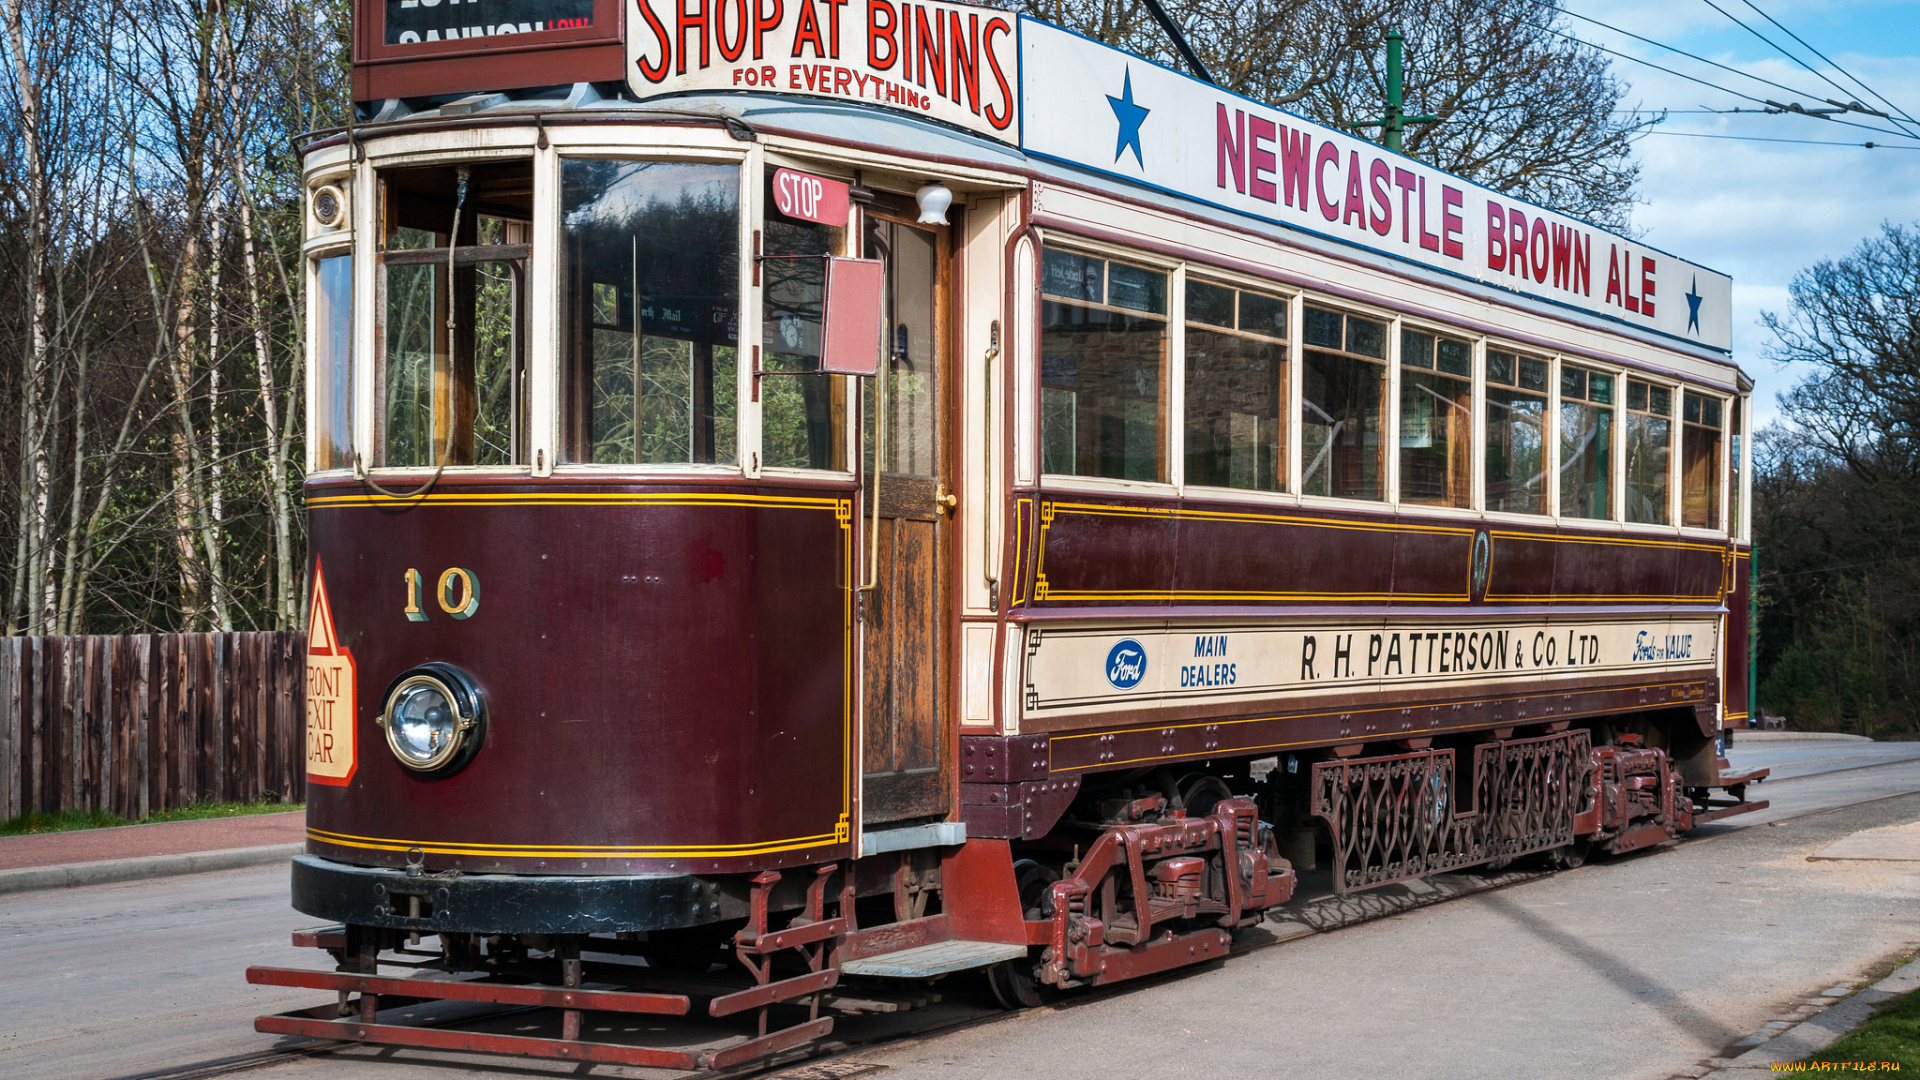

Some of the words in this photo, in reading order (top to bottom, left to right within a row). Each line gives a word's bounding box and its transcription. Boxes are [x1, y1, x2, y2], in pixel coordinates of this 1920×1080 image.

[635, 0, 785, 84] SHOP
[790, 0, 849, 60] AT
[866, 0, 1014, 131] BINNS
[732, 65, 776, 88] FOR
[789, 64, 931, 111] EVERYTHING
[778, 171, 823, 220] STOP
[1215, 101, 1464, 261] NEWCASTLE
[1487, 199, 1591, 298] BROWN
[1605, 243, 1656, 319] ALE
[404, 566, 481, 622] 10
[1109, 648, 1144, 682] Ford
[1193, 635, 1228, 658] MAIN
[1300, 635, 1319, 681] R.
[1333, 634, 1355, 679] H.
[1367, 630, 1509, 674] PATTERSON
[1515, 639, 1524, 668] &
[1665, 634, 1692, 660] VALUE
[1180, 663, 1237, 688] DEALERS
[307, 698, 336, 731] EXIT
[307, 731, 334, 764] CAR
